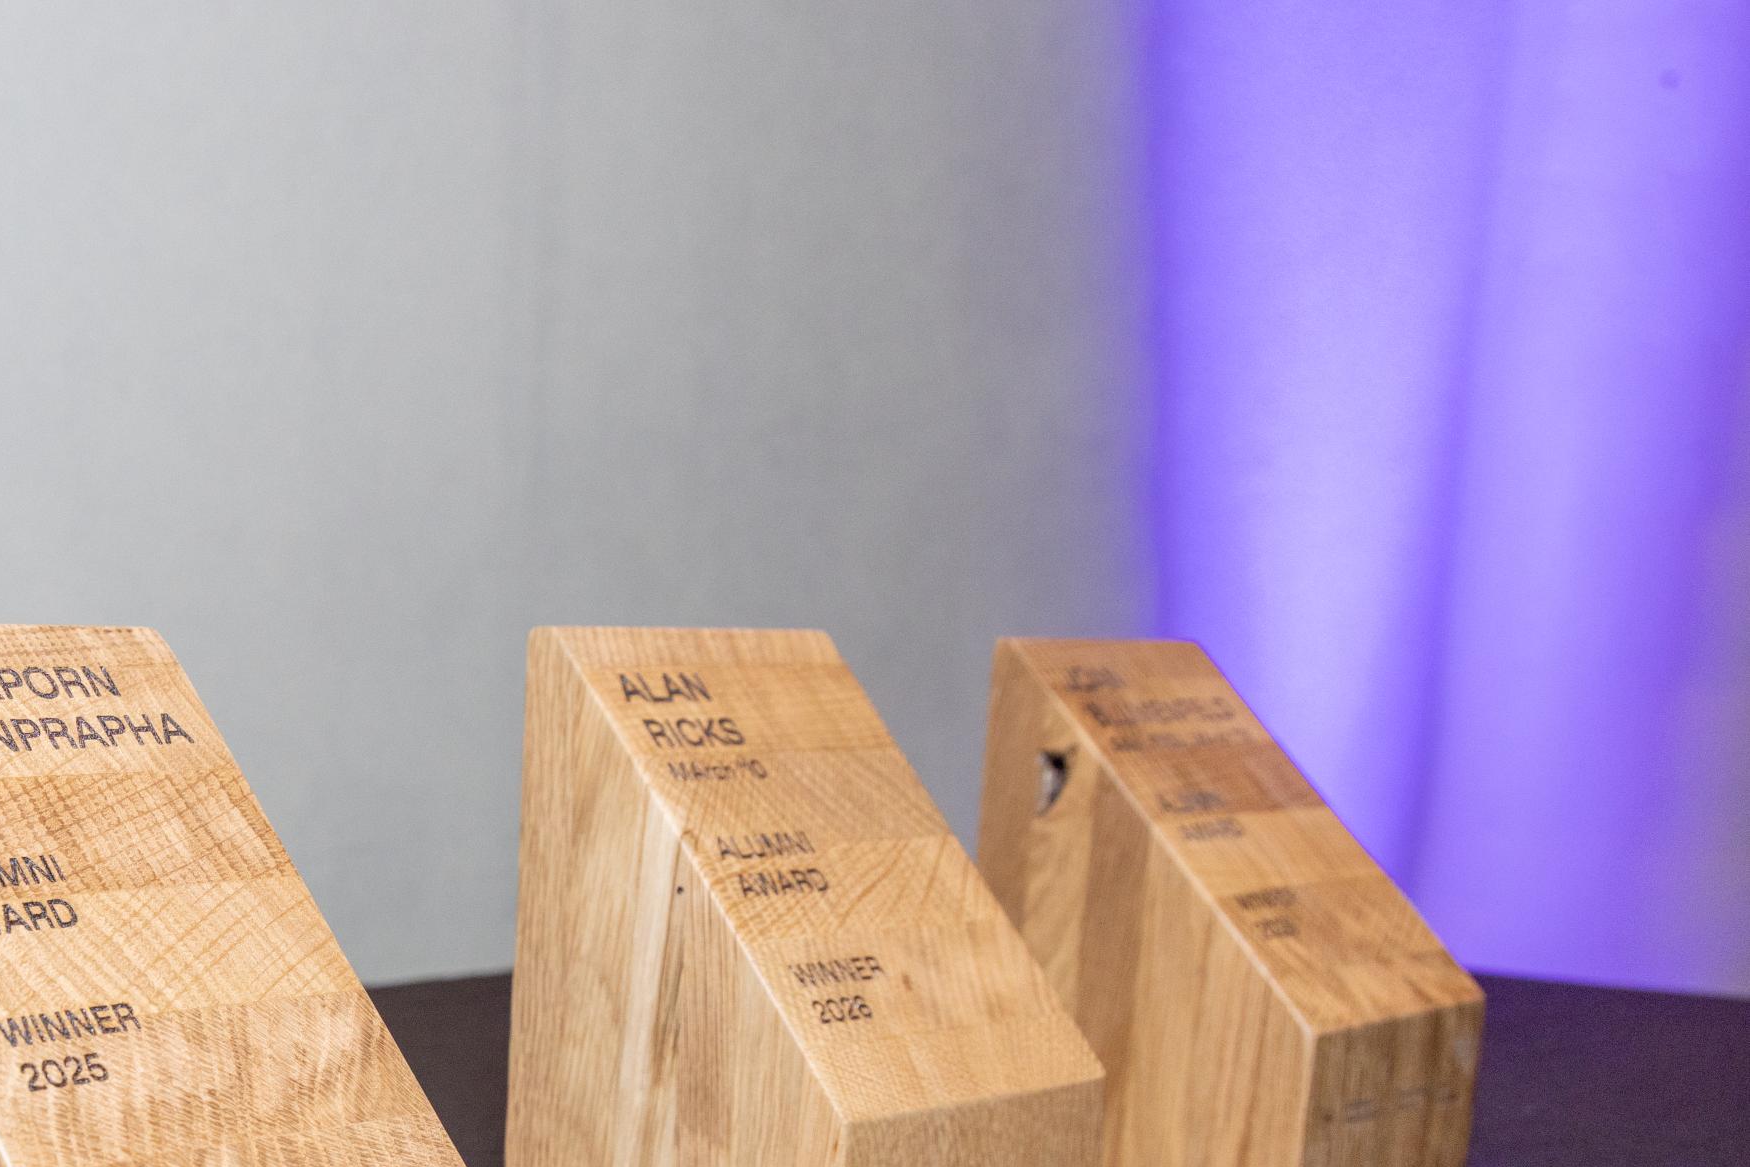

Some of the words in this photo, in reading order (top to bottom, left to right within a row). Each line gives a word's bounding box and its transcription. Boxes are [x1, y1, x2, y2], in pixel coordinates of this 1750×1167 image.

[618, 672, 712, 703] ALAN
[642, 716, 747, 749] RICKS
[717, 830, 816, 860] ALUMNI
[738, 868, 829, 898] AWARD
[788, 956, 887, 988] WINNER
[20, 1052, 110, 1094] 2025
